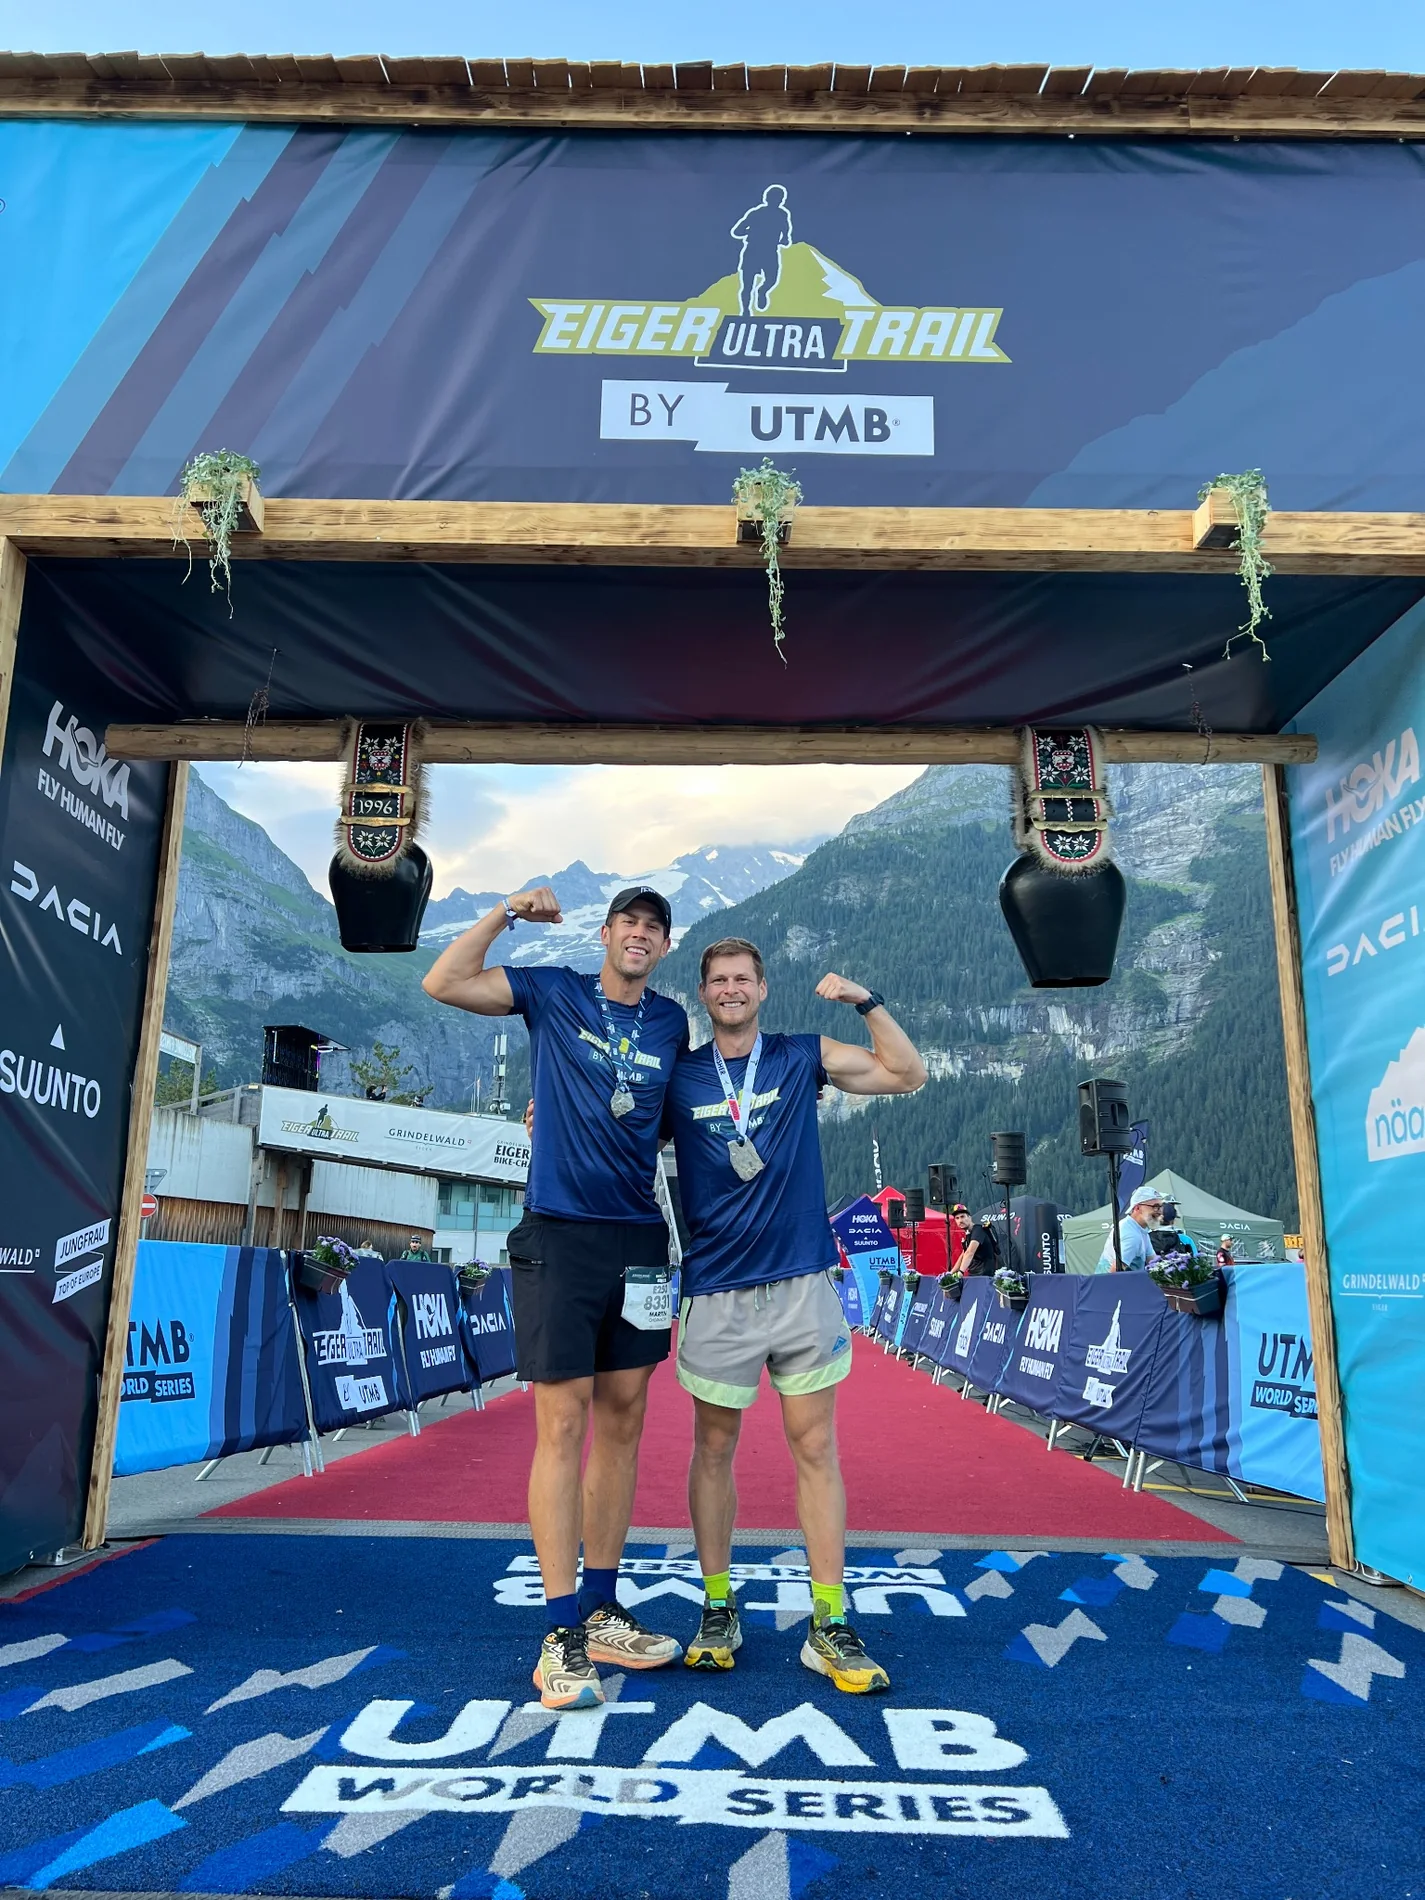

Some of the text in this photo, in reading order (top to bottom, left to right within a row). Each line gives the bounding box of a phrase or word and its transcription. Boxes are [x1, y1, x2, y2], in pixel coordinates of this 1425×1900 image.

[541, 304, 1003, 359] EIGER ULTRA TRAIL
[629, 393, 892, 443] BY UTMB
[42, 700, 131, 821] HOKA
[1326, 727, 1422, 844] HOKA
[37, 768, 126, 851] FLY HUMAN FLY
[358, 800, 393, 815] 1996
[1330, 847, 1350, 877] FLY
[1399, 795, 1425, 830] FLY
[10, 860, 123, 955] DACIA
[1326, 905, 1425, 976] DACI
[0, 1050, 101, 1119] SUUNTO
[692, 1104, 729, 1119] EIGER
[282, 1120, 359, 1141] EIGER ULTRA TRAIL
[388, 1128, 465, 1146] GRINDELWALD
[709, 1123, 721, 1133] BY
[495, 1145, 530, 1159] EIGER
[852, 1214, 878, 1223] HOKA
[980, 1211, 1015, 1222] SUUNO
[1219, 1222, 1250, 1230] DACIA
[60, 1225, 105, 1259] JUNGFRAU
[1041, 1232, 1052, 1275] SUUNTO
[869, 1257, 895, 1265] UTMB
[58, 1265, 100, 1297] TOP OF EUROPE
[1342, 1273, 1421, 1291] GRINDELWALD
[412, 1293, 453, 1340] HOKA
[472, 1312, 507, 1336] DACIA
[1024, 1307, 1064, 1354] HOKA
[982, 1321, 1006, 1345] DACIA
[154, 1377, 192, 1397] SERIES
[1255, 1386, 1293, 1406] WORLD
[339, 1699, 1028, 1773] UTMB
[336, 1775, 1031, 1825] WORLD SERIES
